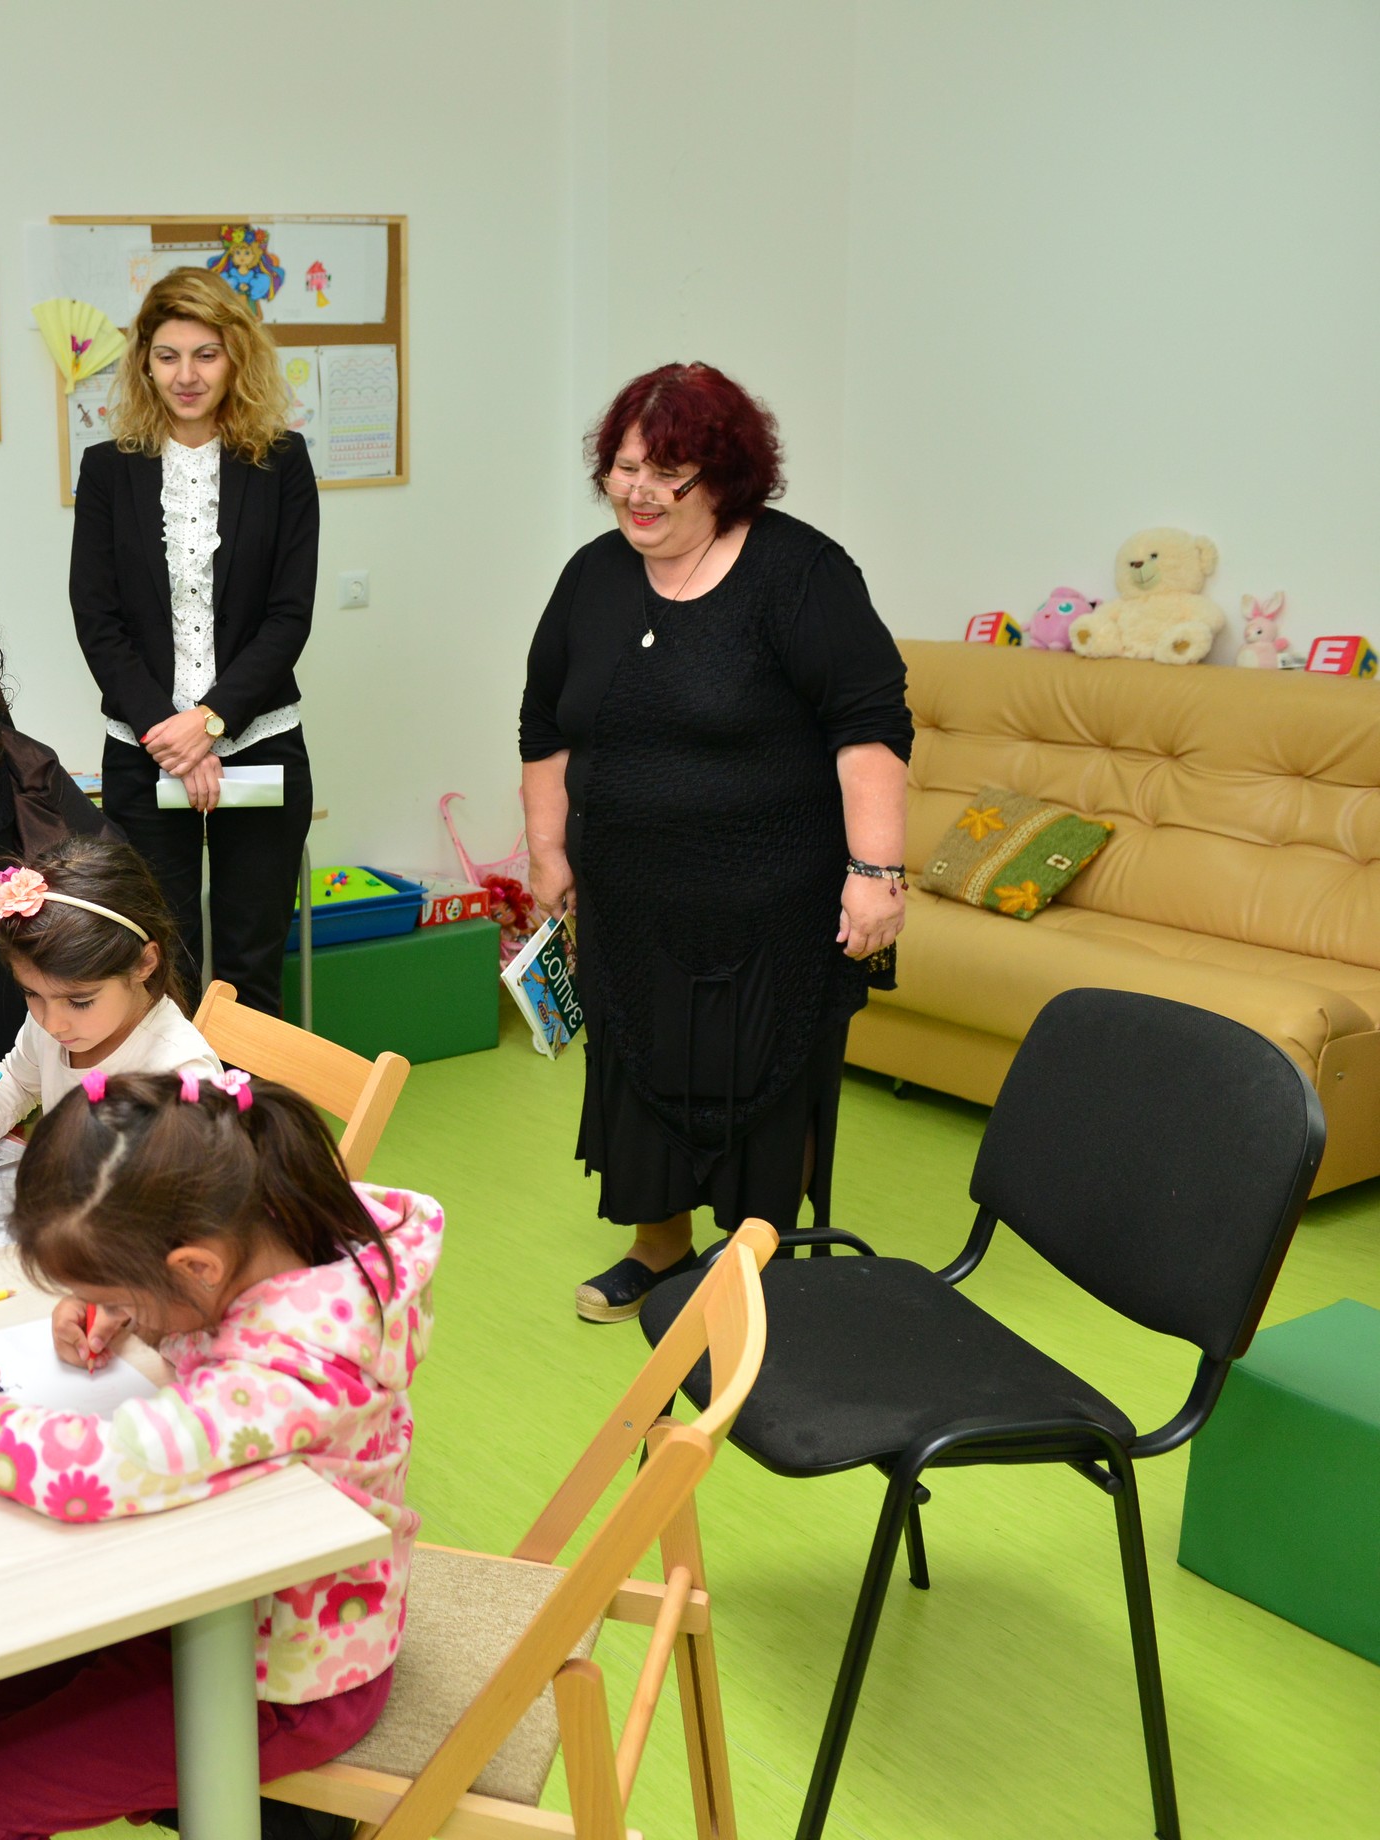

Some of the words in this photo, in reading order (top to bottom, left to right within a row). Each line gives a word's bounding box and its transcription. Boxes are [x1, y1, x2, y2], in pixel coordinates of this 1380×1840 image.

[968, 614, 997, 642] E
[1309, 640, 1350, 672] E
[541, 945, 584, 1029] ЗАЩО?
